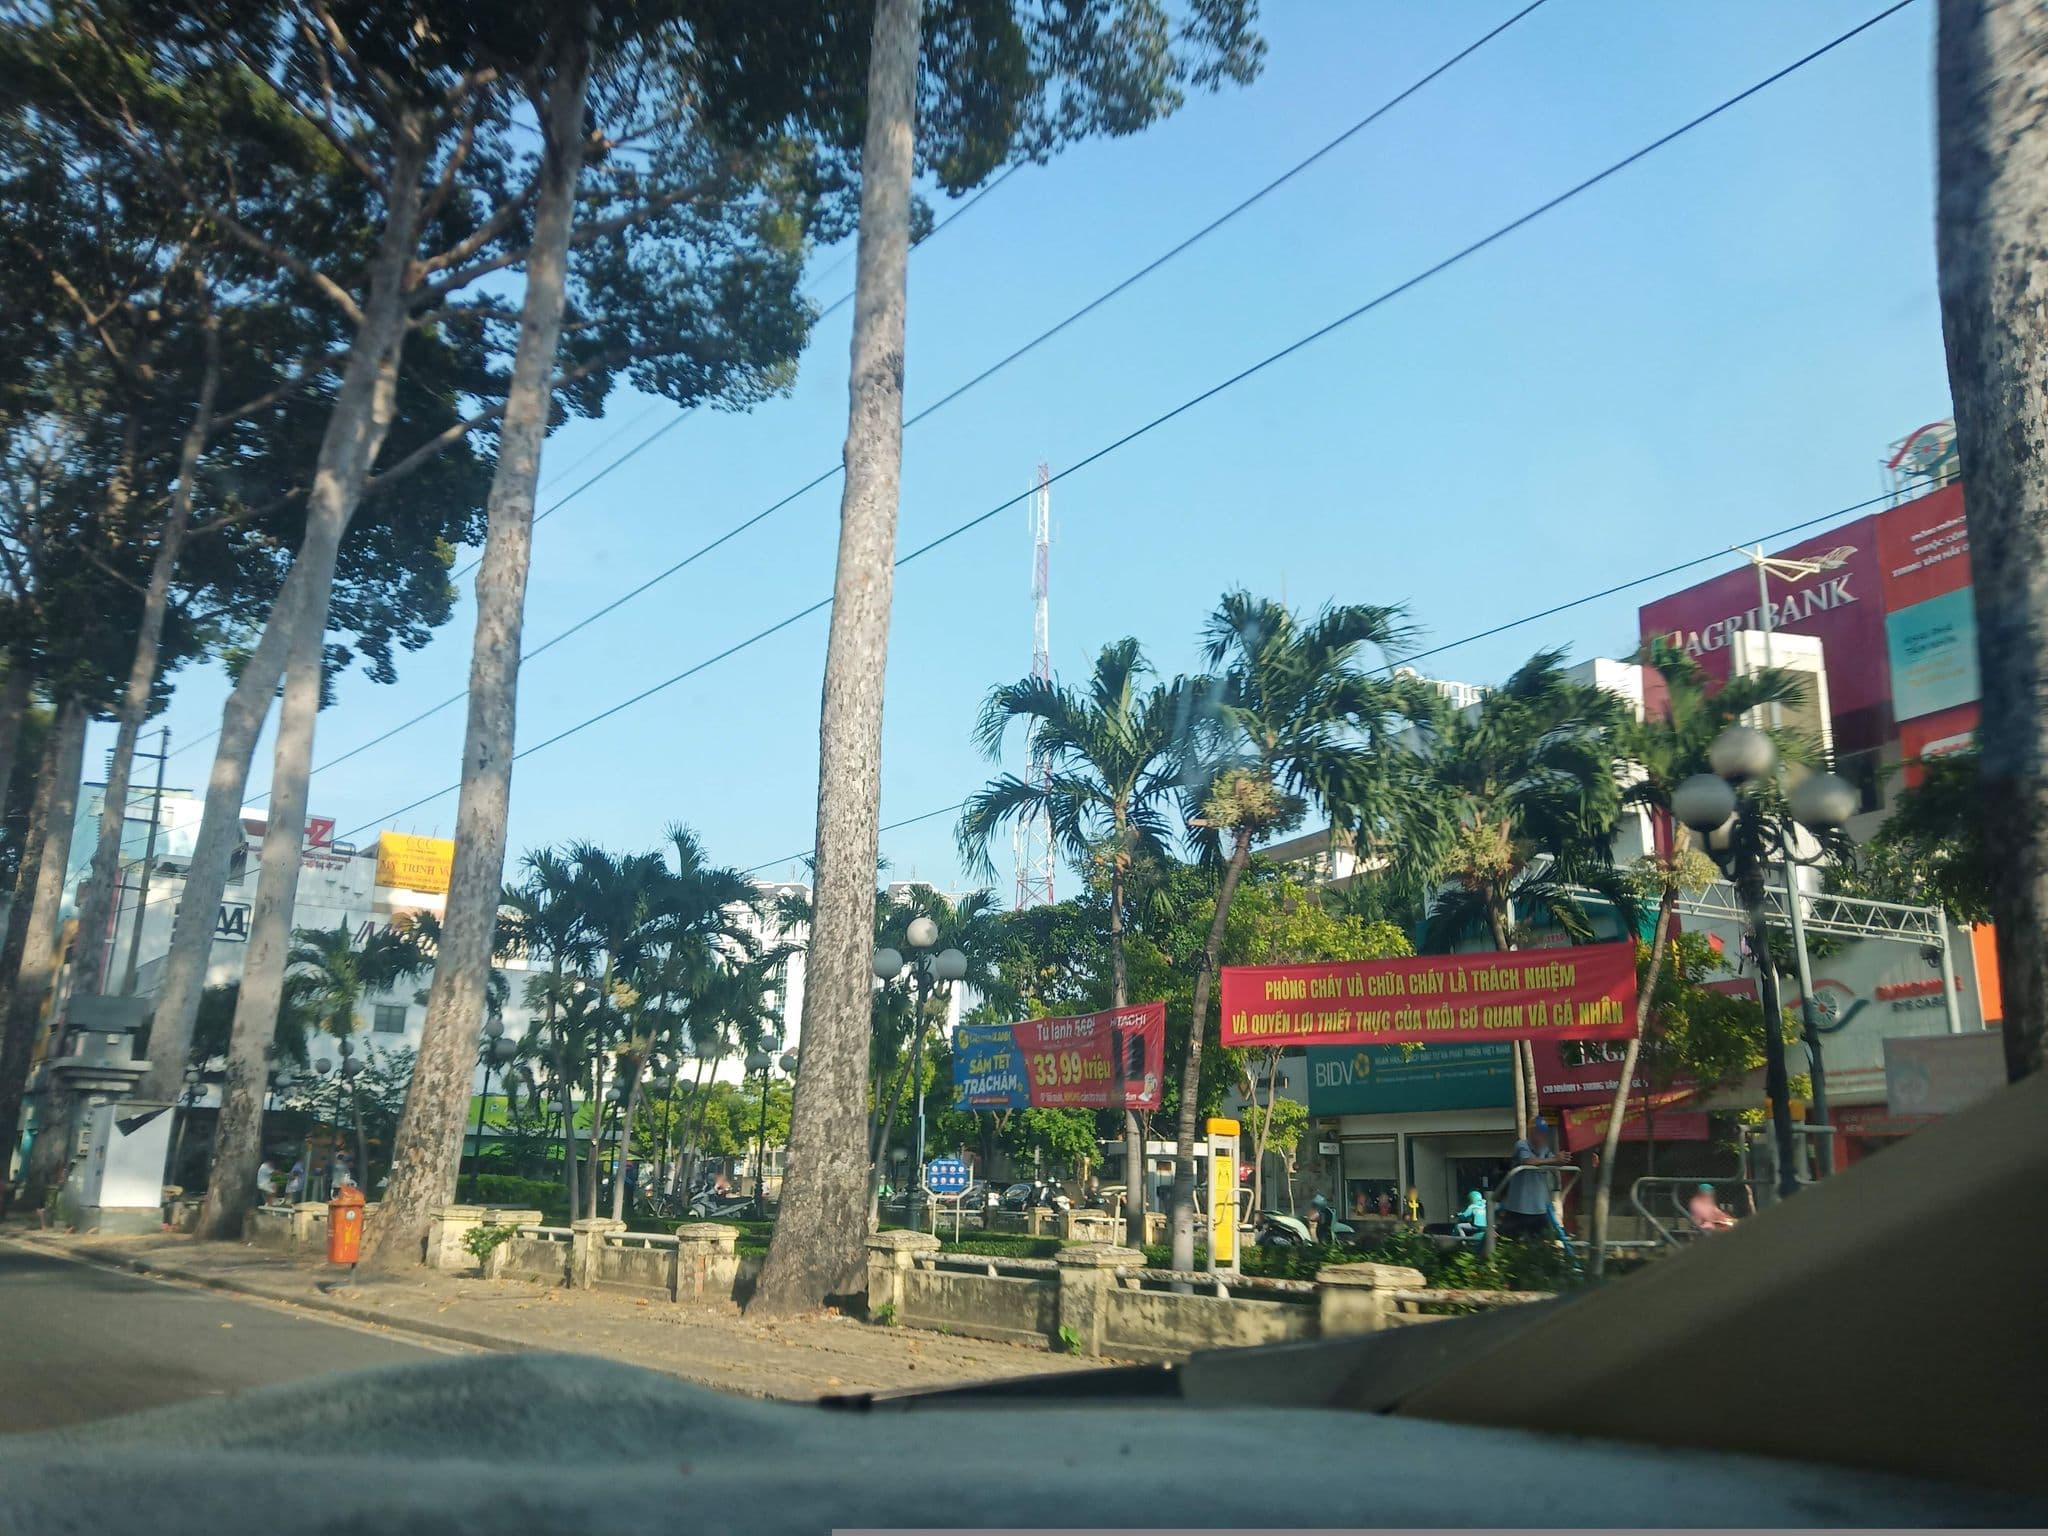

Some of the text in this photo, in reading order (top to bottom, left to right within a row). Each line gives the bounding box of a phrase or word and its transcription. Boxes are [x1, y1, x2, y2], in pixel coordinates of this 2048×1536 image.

[1265, 961, 1576, 1000] PHÒNG CHÁY VÀ CHỮA CHÁY LÀ TRÁCH NHIỆM
[1037, 1022, 1050, 1041] Tủ
[1051, 1019, 1073, 1041] lạnh
[1232, 1010, 1248, 1034] VÀ
[1294, 1010, 1313, 1036] LỢI
[1318, 1007, 1352, 1033] THIẾT
[1356, 1010, 1390, 1036] THỰC
[1394, 1004, 1422, 1031] CỦA
[1459, 1005, 1479, 1029] CƠ
[1483, 1005, 1523, 1030] QUAN
[1528, 1000, 1548, 1026] VÀ
[1553, 997, 1574, 1025] CÁ
[1579, 996, 1624, 1025] NHÂN
[969, 1047, 1011, 1075] SẮM TẾT
[1033, 1051, 1111, 1087] 33,99 triệu
[1315, 1060, 1354, 1087] BIDV
